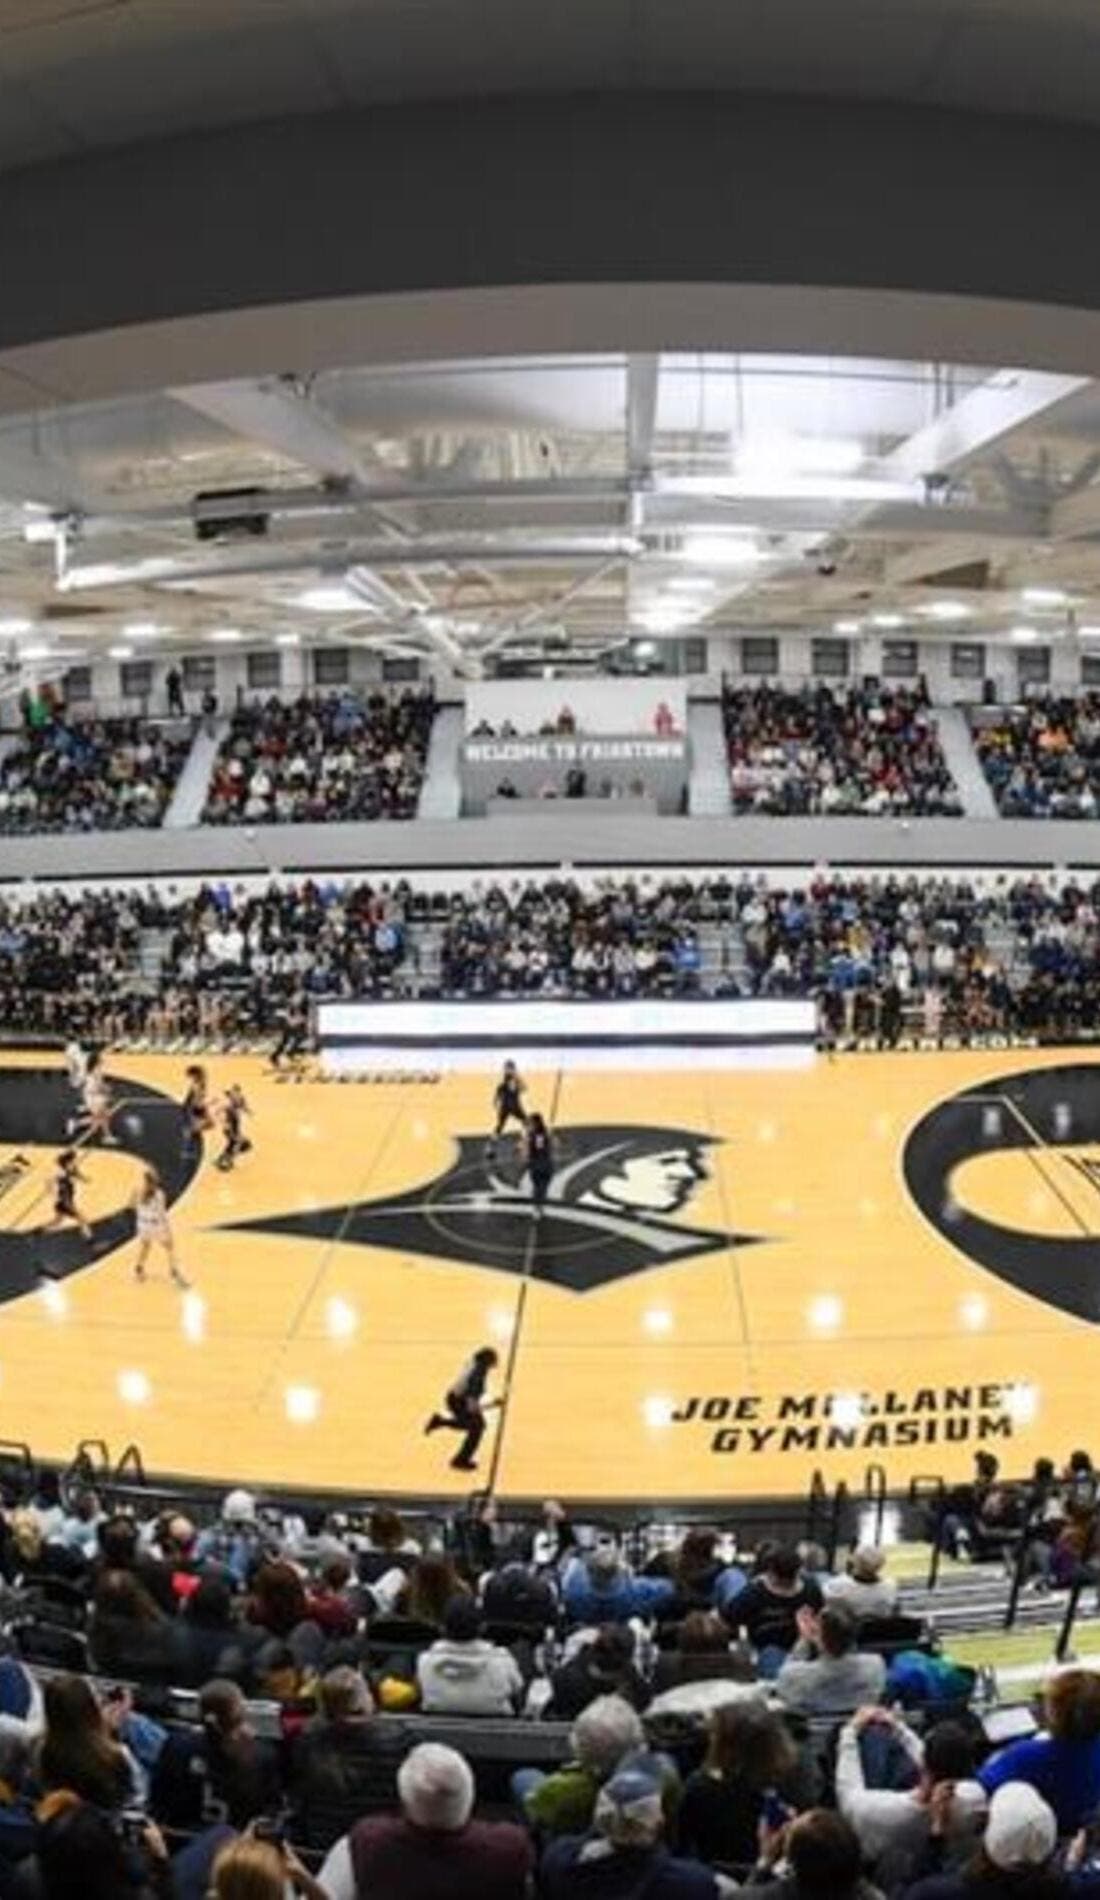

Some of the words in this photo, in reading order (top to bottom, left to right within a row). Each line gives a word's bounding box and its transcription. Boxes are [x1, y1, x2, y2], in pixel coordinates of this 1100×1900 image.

[466, 743, 548, 761] WELCOME
[552, 742, 576, 760] TO
[672, 1397, 761, 1422] JOE
[778, 1382, 1027, 1419] MLANE
[711, 1415, 1012, 1453] GYMNASIUM
